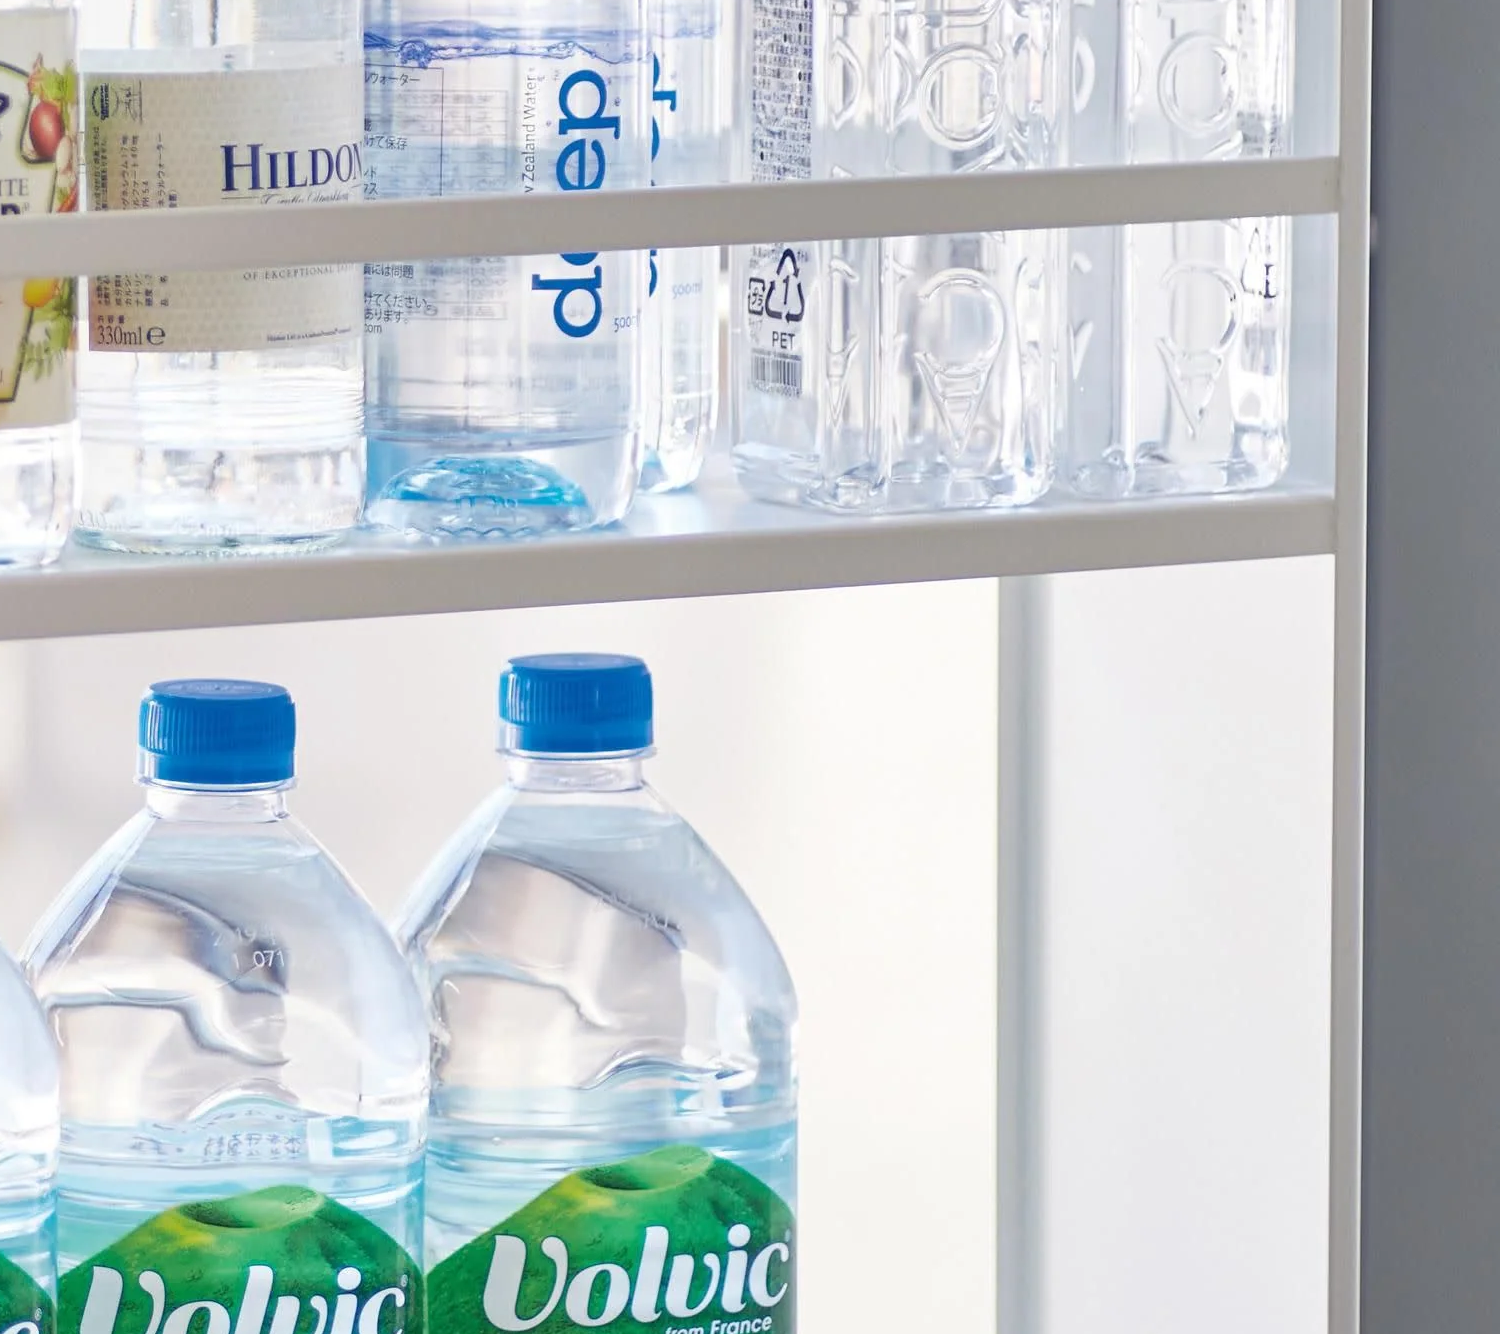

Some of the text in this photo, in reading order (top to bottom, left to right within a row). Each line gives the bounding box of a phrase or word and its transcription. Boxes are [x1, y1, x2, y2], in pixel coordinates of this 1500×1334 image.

[521, 75, 538, 183] Zealand Water
[219, 140, 363, 192] HILDON
[531, 69, 621, 339] dep
[243, 270, 260, 281] OF
[264, 265, 335, 281] EXCEPTIONAL
[96, 325, 143, 346] 330ml
[772, 330, 796, 350] PET
[482, 1223, 790, 1332] Volvic
